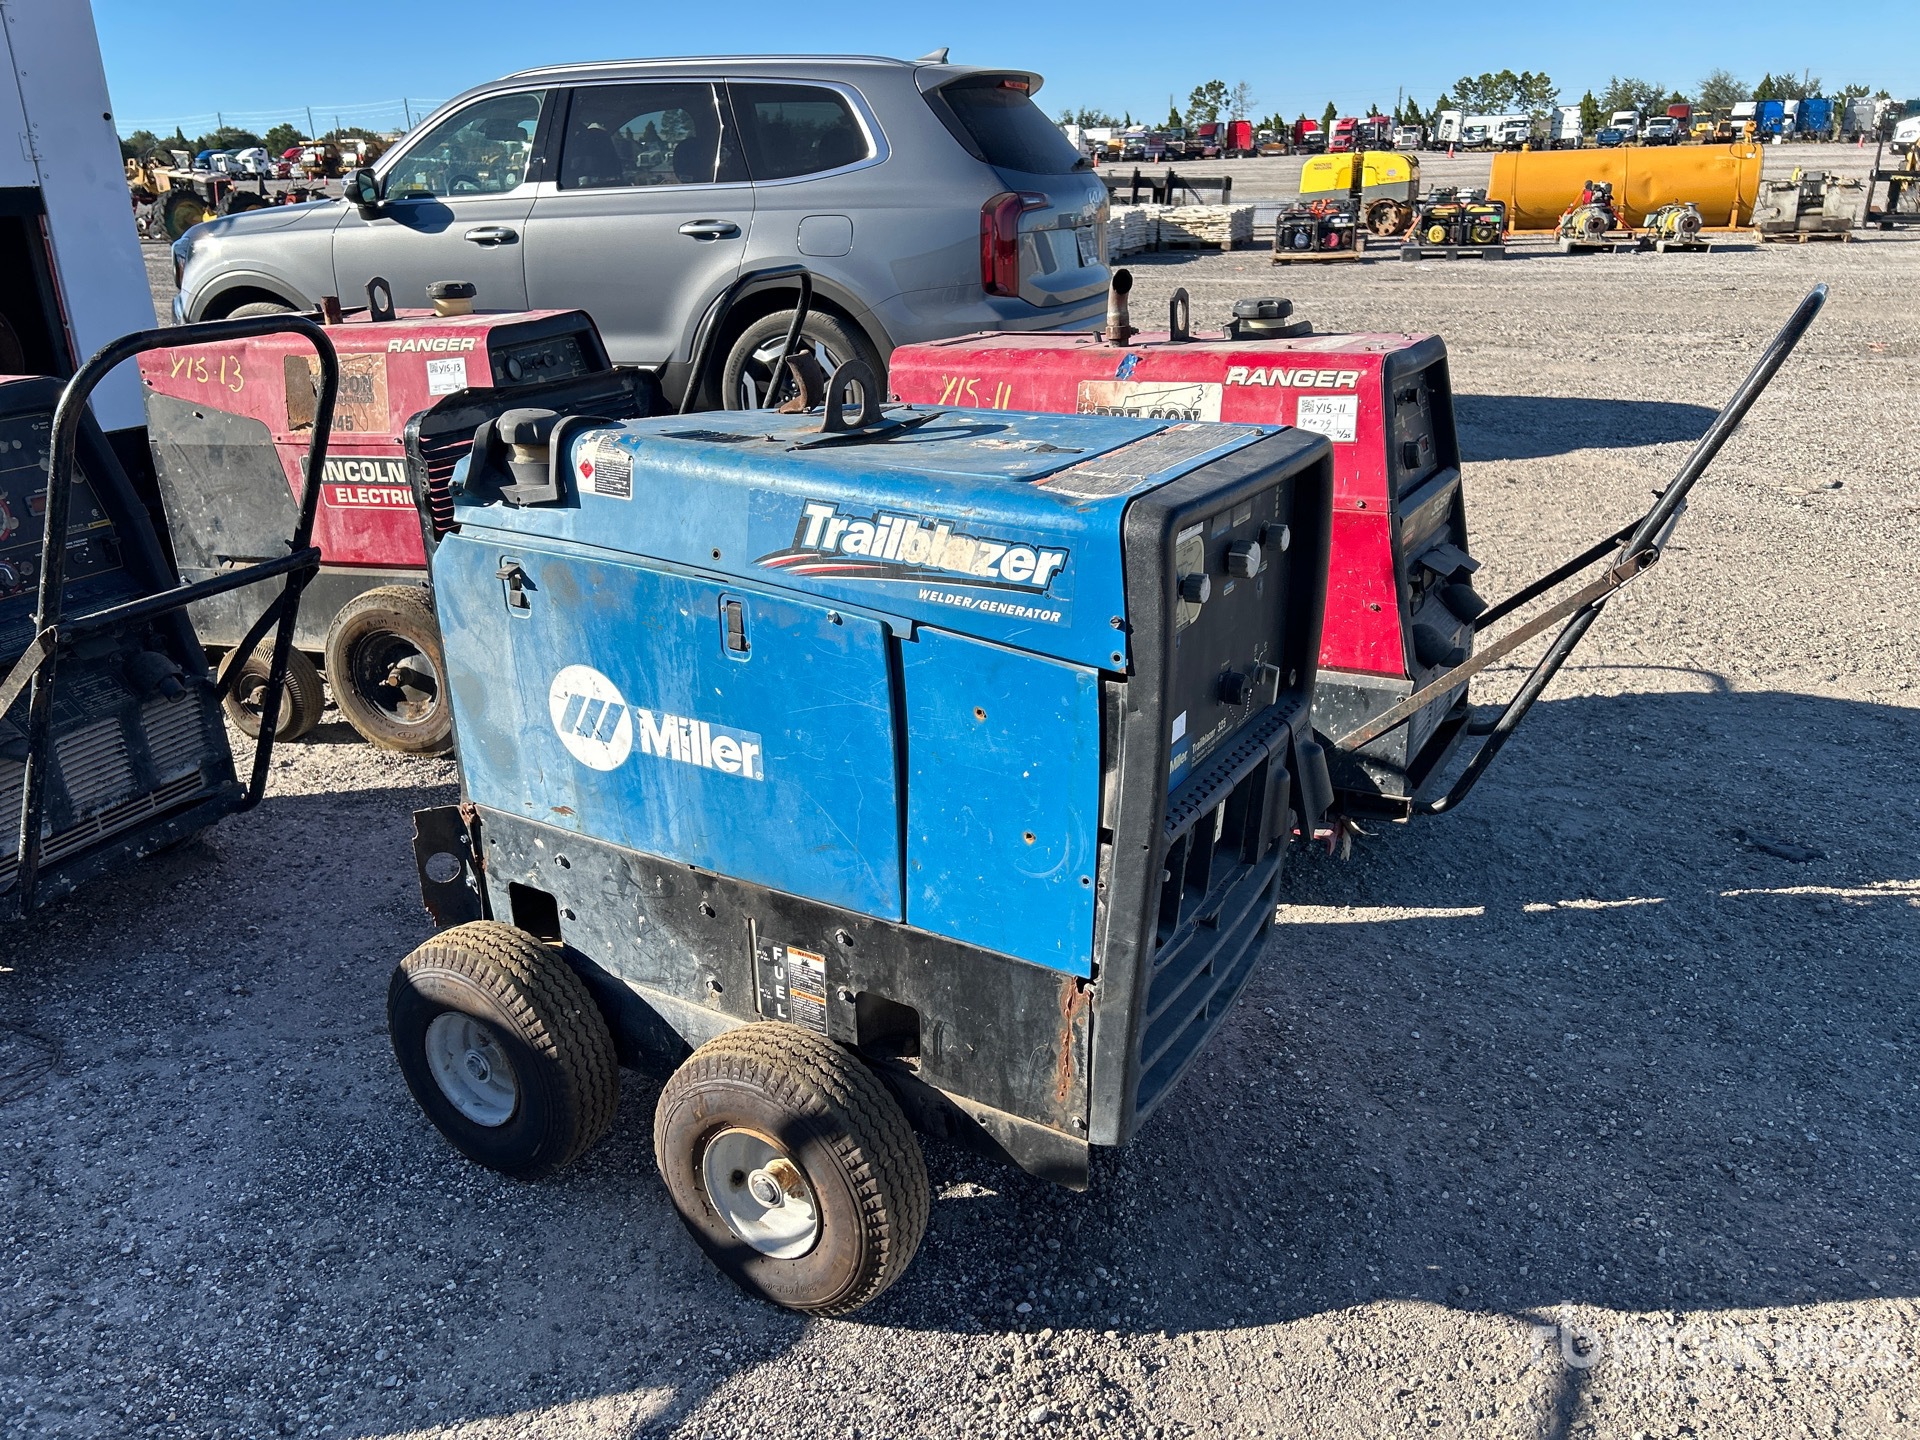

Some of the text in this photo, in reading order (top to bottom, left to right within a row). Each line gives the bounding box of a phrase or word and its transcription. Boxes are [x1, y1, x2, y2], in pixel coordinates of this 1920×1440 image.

[387, 338, 476, 353] RANGER
[729, 347, 746, 384] KUMHO
[1225, 366, 1360, 389] RANGER
[322, 461, 406, 483] INCOLN
[799, 501, 1065, 586] Trailblazer
[918, 588, 1062, 623] WELDER/GENERATOR
[638, 708, 760, 778] Miller
